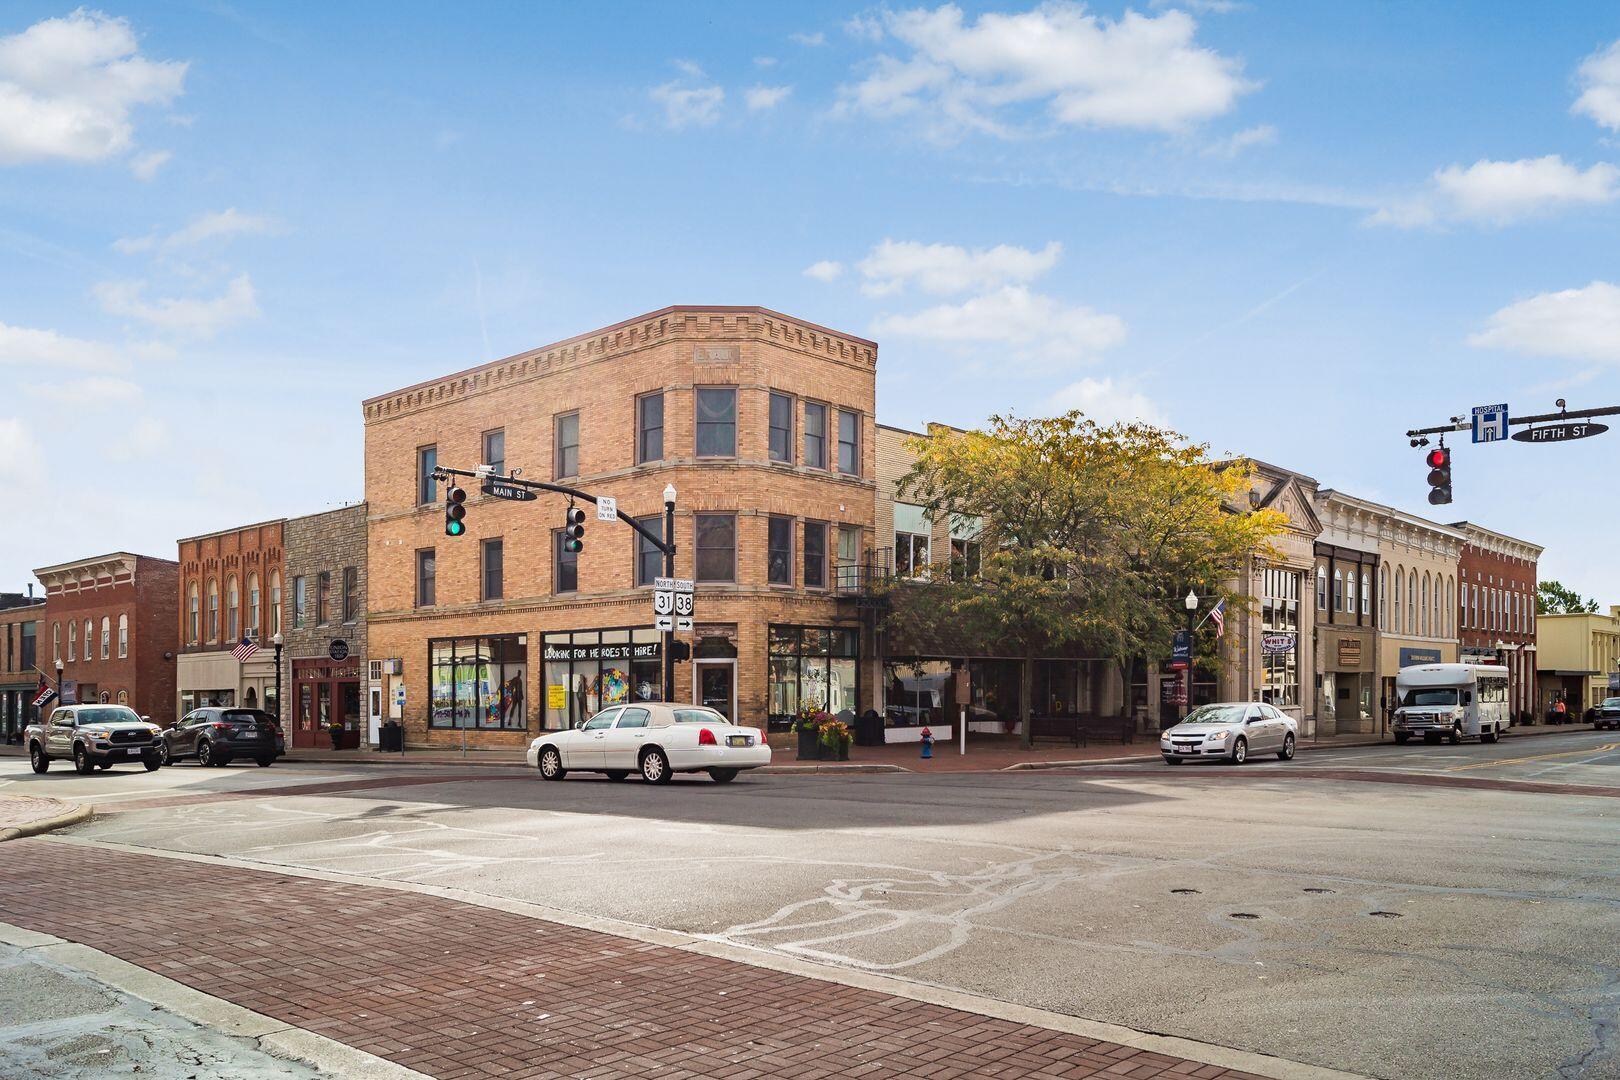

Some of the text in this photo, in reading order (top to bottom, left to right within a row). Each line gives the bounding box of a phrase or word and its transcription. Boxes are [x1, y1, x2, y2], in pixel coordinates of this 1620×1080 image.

[1474, 404, 1504, 415] HOSPITAL
[1532, 425, 1588, 440] FIFTH ST
[493, 486, 526, 499] MAIN ST
[655, 580, 673, 589] NORTH
[676, 581, 693, 590] SOUTH
[658, 596, 670, 609] 31
[677, 597, 692, 611] 38
[573, 648, 587, 659] FOR
